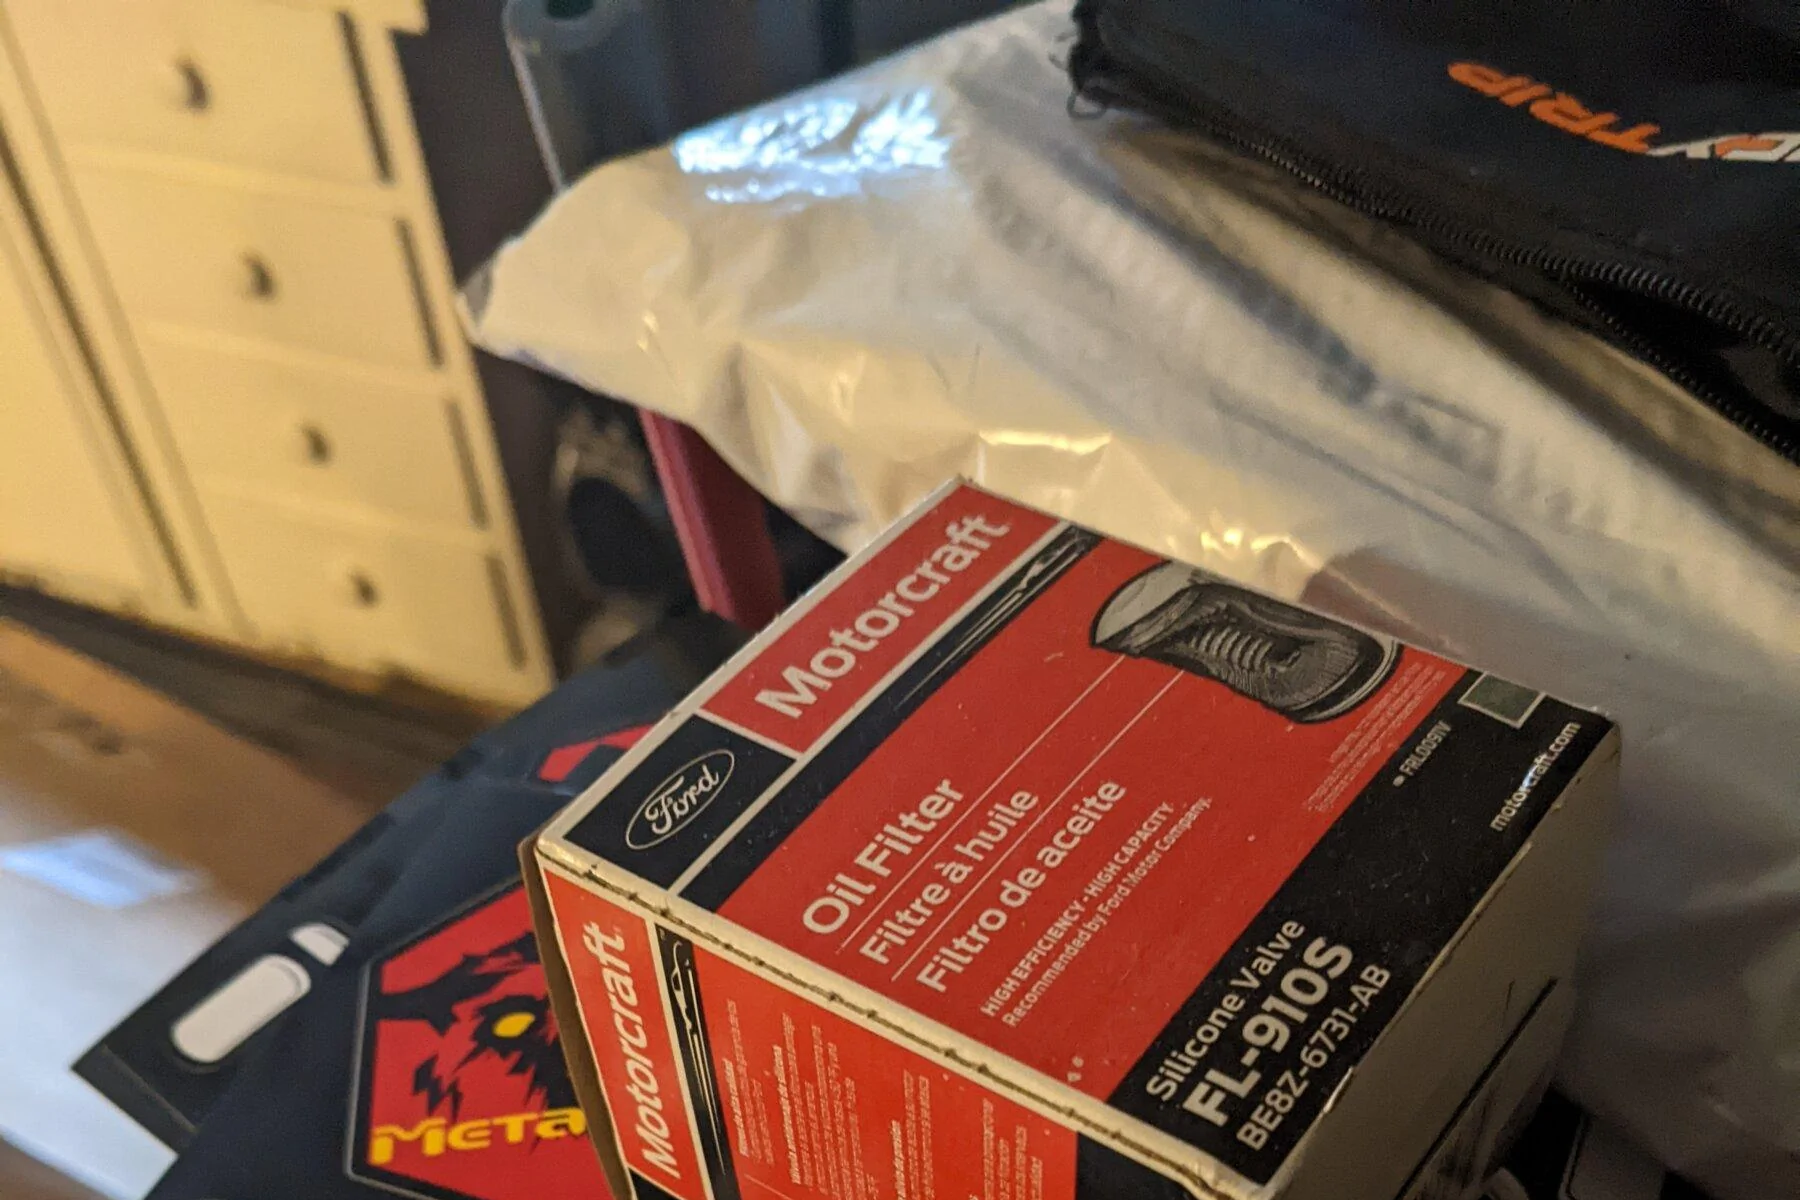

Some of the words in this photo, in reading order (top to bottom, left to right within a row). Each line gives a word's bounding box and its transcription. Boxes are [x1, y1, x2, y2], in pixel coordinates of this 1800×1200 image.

[754, 515, 1010, 719] Motorcraft
[641, 766, 720, 836] Ford
[802, 873, 876, 934] Oil
[853, 779, 964, 877] Filter
[953, 791, 1039, 862] huile
[1490, 722, 1581, 831] motorcraft.com
[859, 883, 951, 964] Filtre
[916, 908, 1008, 993] Filtro
[999, 867, 1046, 908] de
[1036, 781, 1126, 868] aceite
[934, 861, 974, 884] à
[980, 977, 1021, 1017] HIGH
[1011, 899, 1085, 981] EFFICIENCY
[1084, 861, 1122, 897] HIGH
[1113, 801, 1174, 864] CAPACITY
[1001, 928, 1092, 1027] Recommended
[1082, 913, 1108, 933] by
[1096, 884, 1132, 916] Ford
[1121, 849, 1162, 887] Motor
[582, 921, 681, 1179] Motorcraft
[1146, 993, 1246, 1102] Silicone
[1229, 920, 1305, 989] Valve
[1182, 936, 1353, 1127] FL-910S
[1236, 964, 1391, 1150] BE8Z-6731-AB
